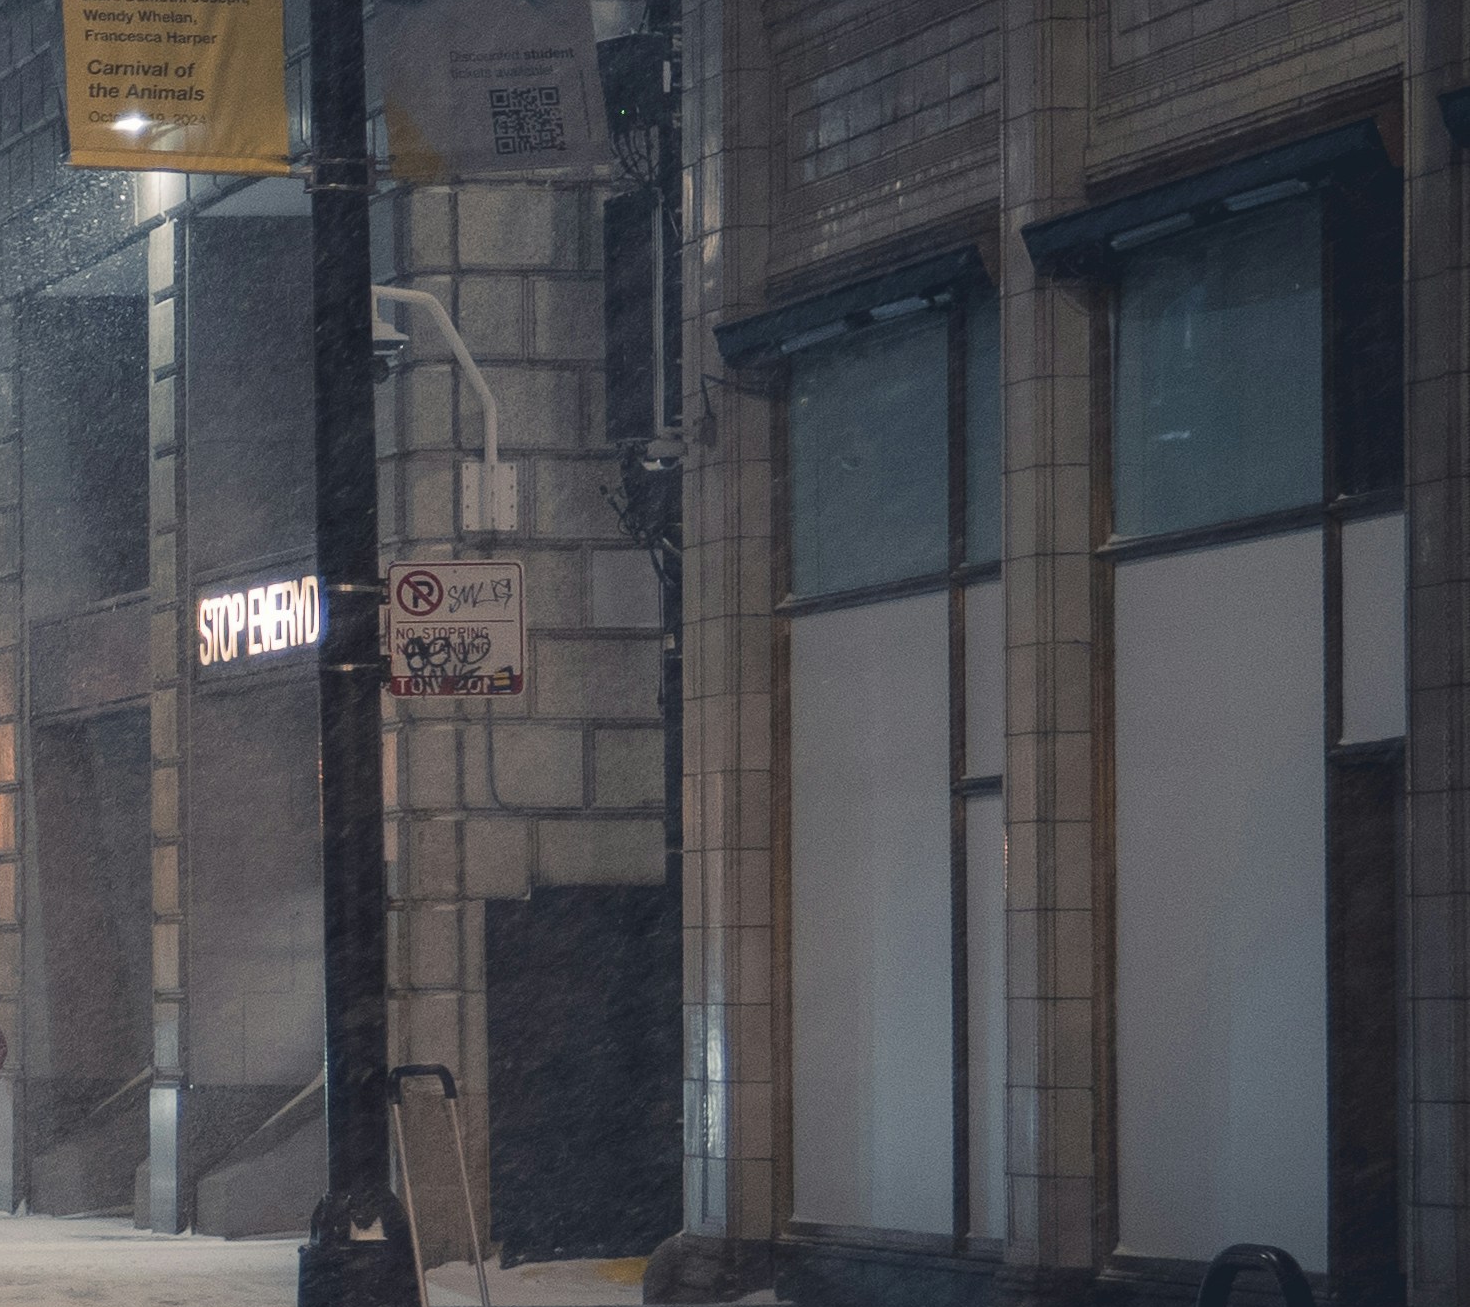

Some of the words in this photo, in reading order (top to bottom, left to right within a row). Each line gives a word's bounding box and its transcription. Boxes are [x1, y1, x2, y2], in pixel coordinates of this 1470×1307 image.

[83, 9, 134, 24] Wendy
[138, 10, 197, 25] Whelan,
[84, 29, 162, 43] Francesca
[166, 31, 218, 46] Harper
[450, 51, 520, 63] Discounted
[524, 48, 575, 60] student
[87, 59, 168, 77] Carnival
[174, 62, 196, 78] of
[88, 83, 120, 99] the
[125, 84, 205, 101] Animals
[88, 110, 147, 125] Octo
[198, 592, 247, 666] STOP
[247, 575, 320, 656] EVERYD
[396, 628, 415, 640] NO
[422, 626, 489, 640] STOPPING
[423, 641, 490, 654] TANDING
[396, 677, 443, 693] TOW
[454, 676, 503, 693] ZON
